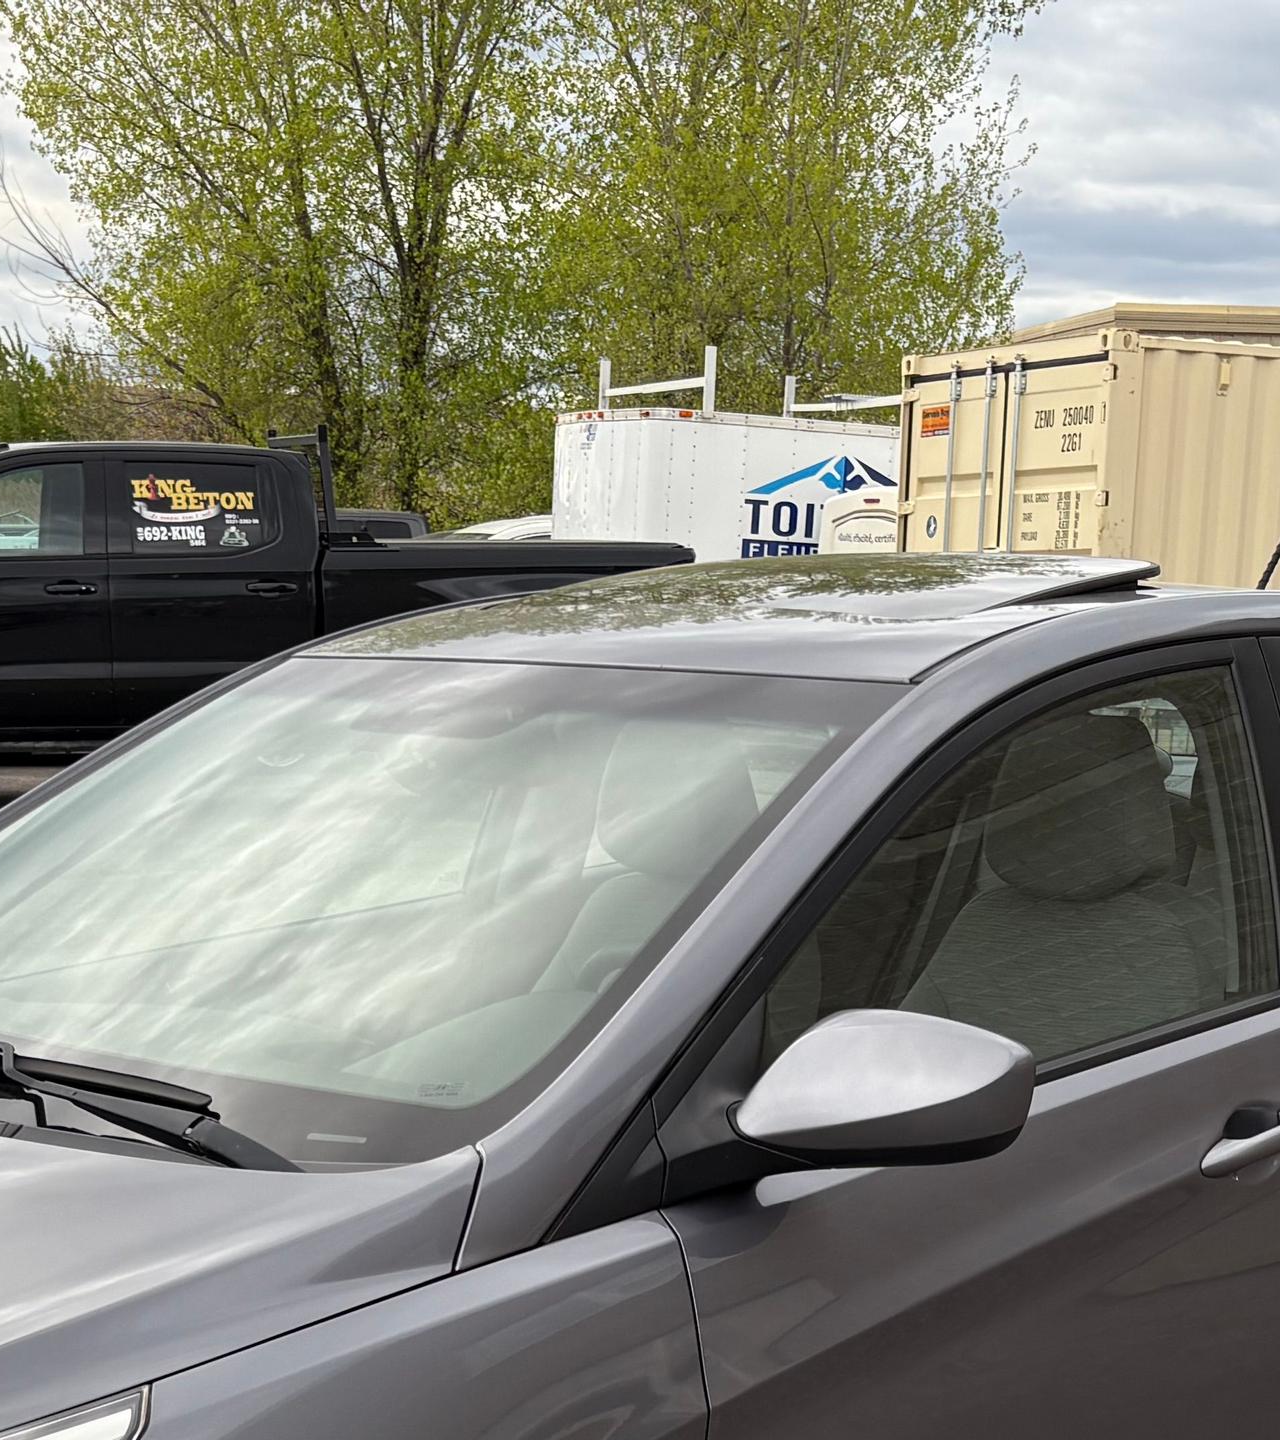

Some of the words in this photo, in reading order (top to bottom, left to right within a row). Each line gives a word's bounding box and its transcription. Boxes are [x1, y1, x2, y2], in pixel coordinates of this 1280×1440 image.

[1034, 409, 1055, 429] ZENU
[1063, 404, 1094, 427] 250040
[1061, 432, 1082, 453] 22G1
[171, 491, 255, 510] BETON
[744, 498, 824, 539] TOI
